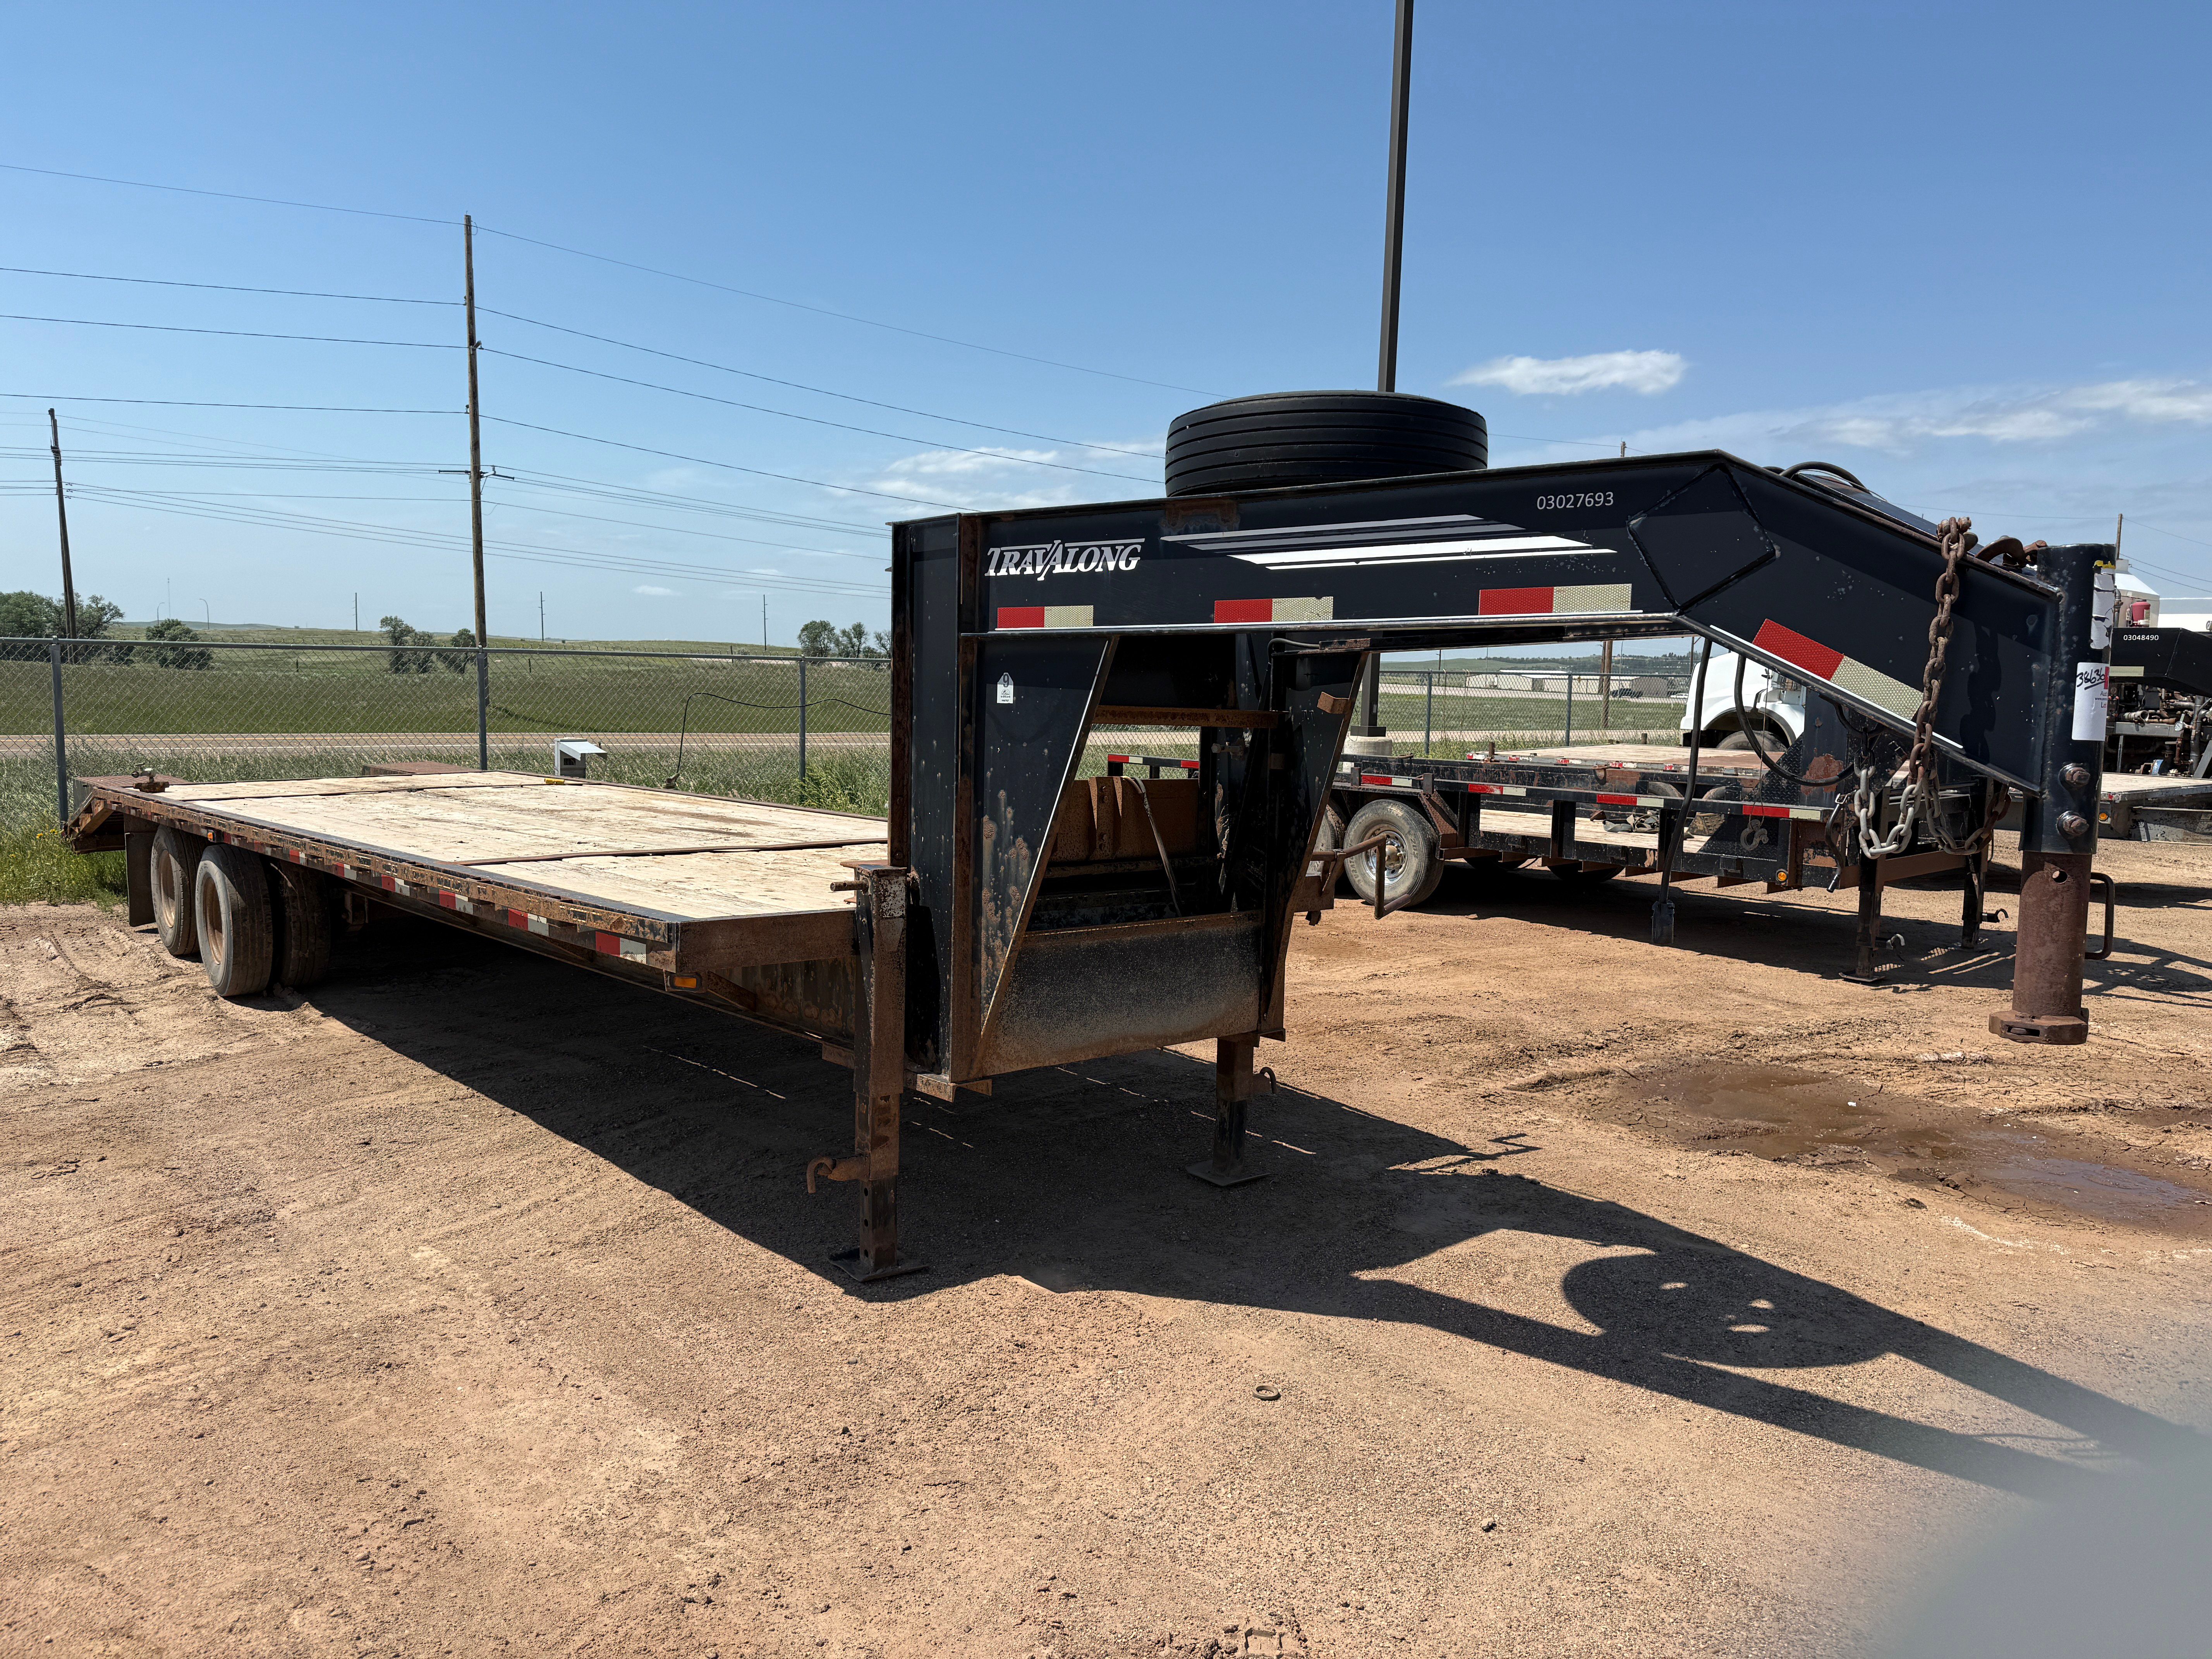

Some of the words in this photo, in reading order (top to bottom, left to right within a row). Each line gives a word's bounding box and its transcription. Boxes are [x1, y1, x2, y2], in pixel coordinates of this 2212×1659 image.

[1537, 492, 1614, 510] 03027693
[984, 539, 1145, 581] TRAVALONG
[1003, 673, 1010, 688] 9
